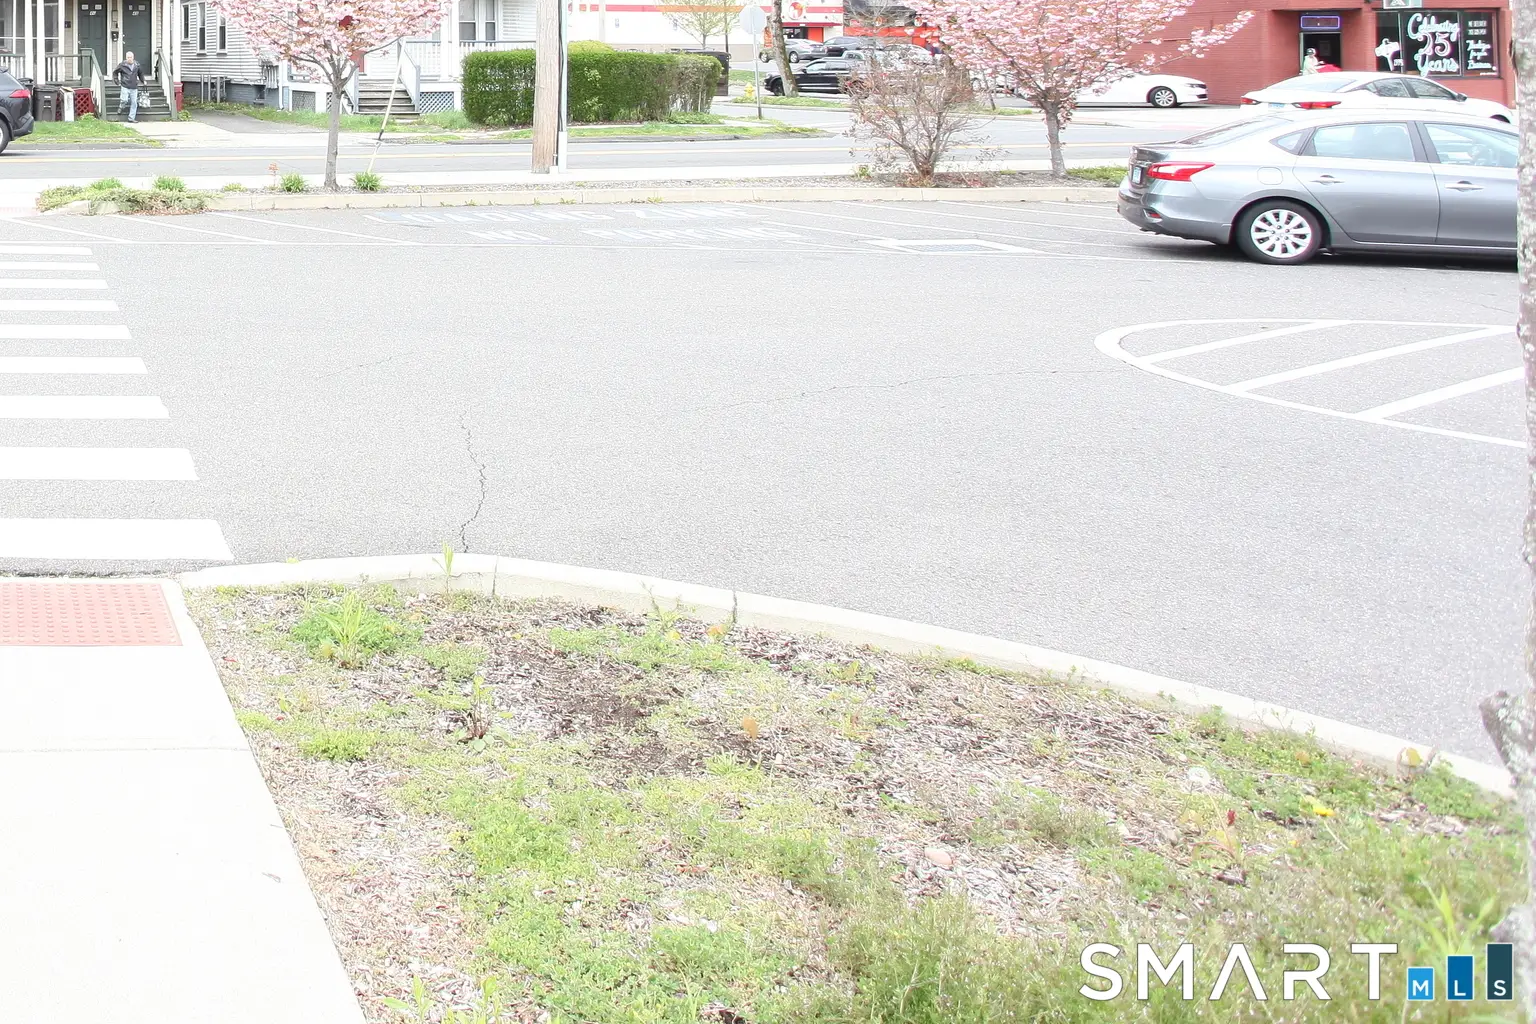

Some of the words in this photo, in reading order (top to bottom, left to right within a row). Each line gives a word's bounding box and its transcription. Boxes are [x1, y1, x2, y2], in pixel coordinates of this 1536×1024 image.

[1417, 32, 1452, 57] 25
[1413, 54, 1459, 77] Years
[361, 211, 615, 224] LOADING
[613, 207, 769, 219] ZONE
